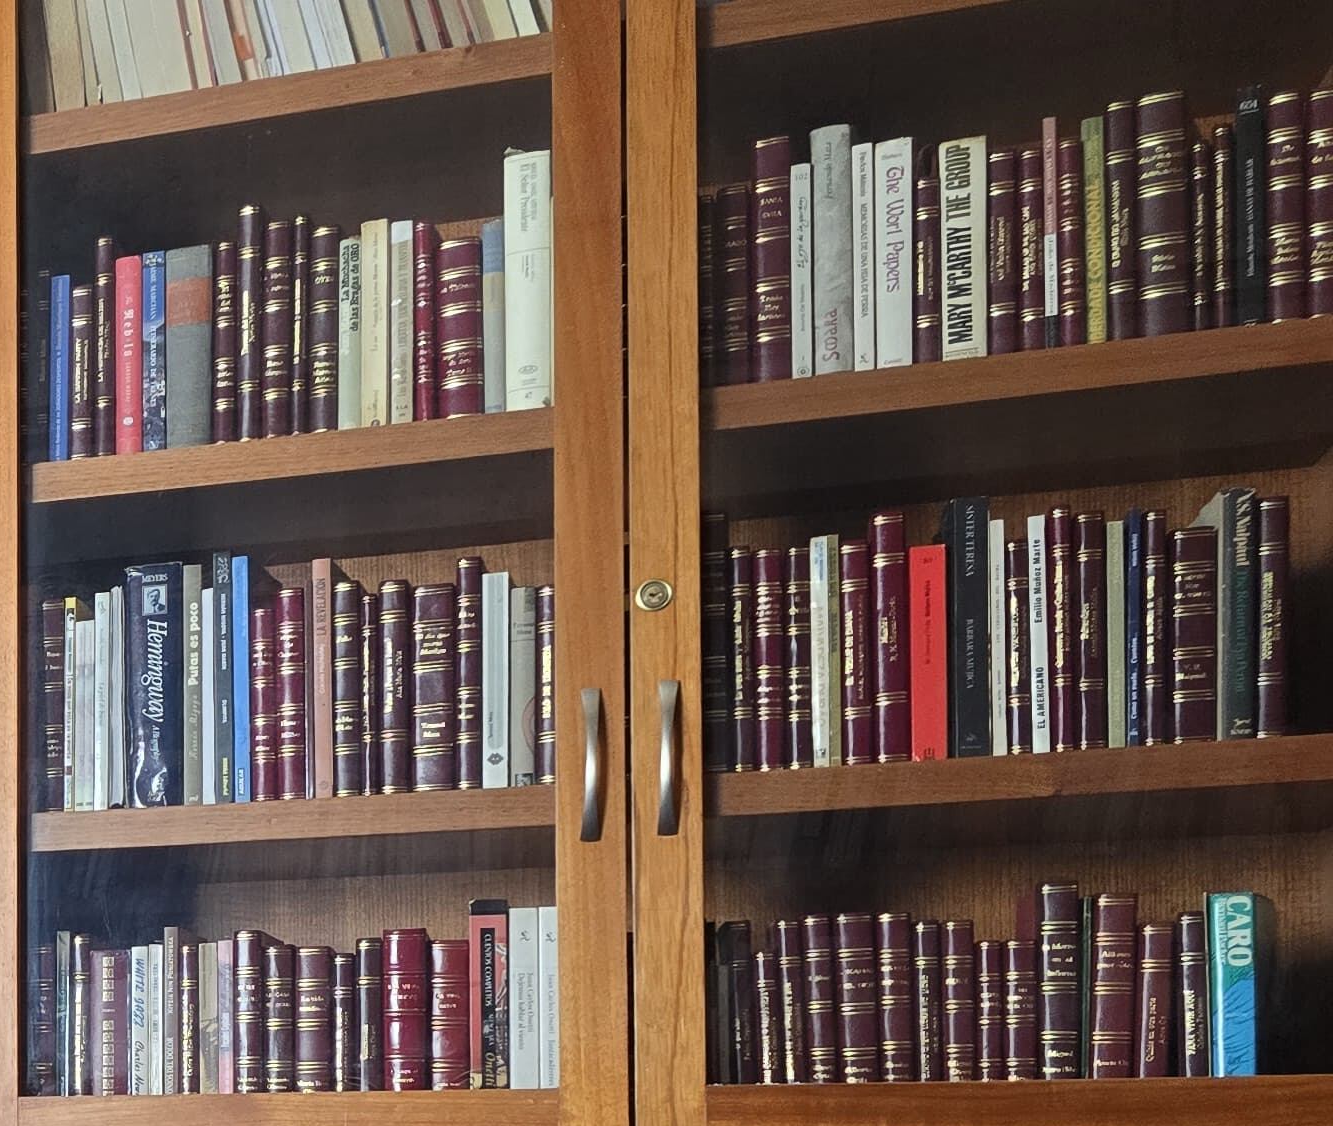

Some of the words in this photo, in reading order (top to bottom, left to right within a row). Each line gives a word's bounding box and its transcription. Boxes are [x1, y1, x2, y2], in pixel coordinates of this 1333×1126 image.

[885, 166, 905, 195] The
[945, 144, 971, 190] GROUP
[945, 192, 971, 223] THE
[341, 245, 350, 288] Muchacha
[350, 243, 359, 262] ORO
[882, 240, 905, 294] Papers
[350, 263, 359, 274] de
[341, 289, 350, 302] La
[350, 306, 359, 321] las
[350, 321, 359, 332] de
[946, 303, 973, 345] MARY
[964, 505, 975, 539] SISTER
[1032, 539, 1042, 565] Marte
[1232, 515, 1251, 568] Naipaul
[964, 539, 975, 577] TERESA
[141, 574, 169, 584] MEYERS
[1032, 566, 1043, 595] Muñoz
[187, 601, 200, 631] poco
[1033, 596, 1043, 623] Emilio
[187, 634, 200, 649] es
[316, 625, 327, 636] LA
[141, 619, 168, 722] Hemingway
[187, 651, 200, 686] Putas
[1035, 666, 1046, 717] AMERICANO
[1036, 718, 1046, 729] EL
[1227, 895, 1253, 967] CARO
[483, 933, 494, 966] CUENTOS
[133, 958, 146, 996] WHITE
[483, 966, 494, 1008] COMPLETOS
[526, 972, 535, 987] Juan
[133, 997, 146, 1029] JAZZ
[526, 987, 535, 1008] Carlos
[133, 1039, 146, 1074] Charles
[484, 1051, 498, 1087] Onetti
